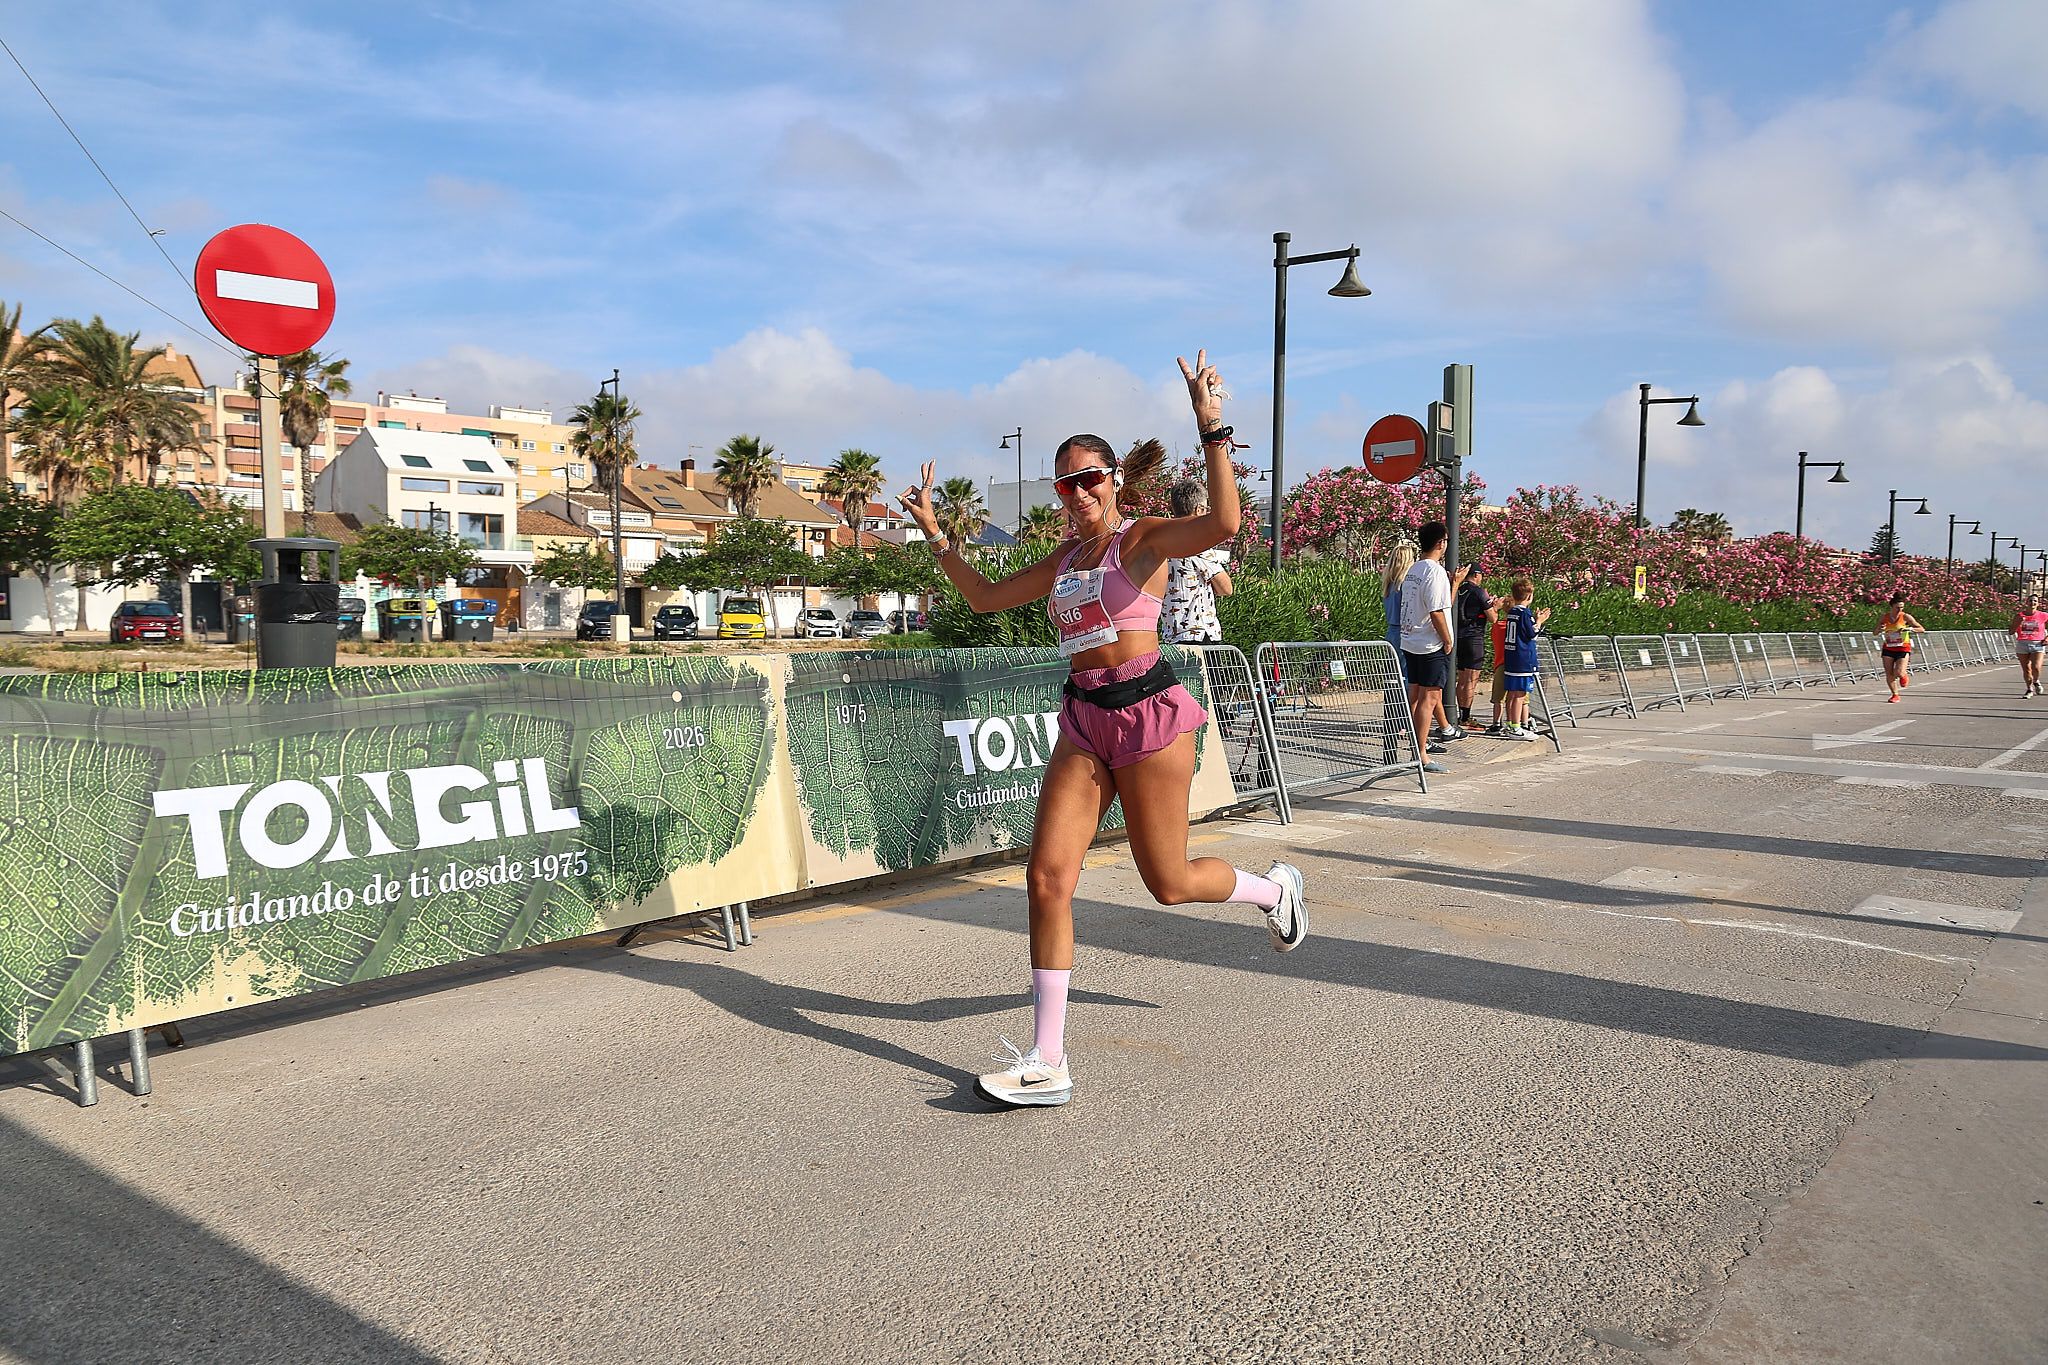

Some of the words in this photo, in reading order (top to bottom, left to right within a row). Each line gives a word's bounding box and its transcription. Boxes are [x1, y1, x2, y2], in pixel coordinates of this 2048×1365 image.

[1505, 621, 1517, 644] 10
[835, 704, 867, 725] 1975
[663, 726, 705, 749] 2026
[942, 711, 1061, 776] TON
[956, 781, 1029, 809] Cuidando
[1031, 777, 1043, 799] d
[170, 881, 352, 938] Cuidando
[362, 872, 401, 907] de
[409, 866, 430, 899] ti
[439, 854, 523, 894] desde
[530, 848, 589, 881] 1975
